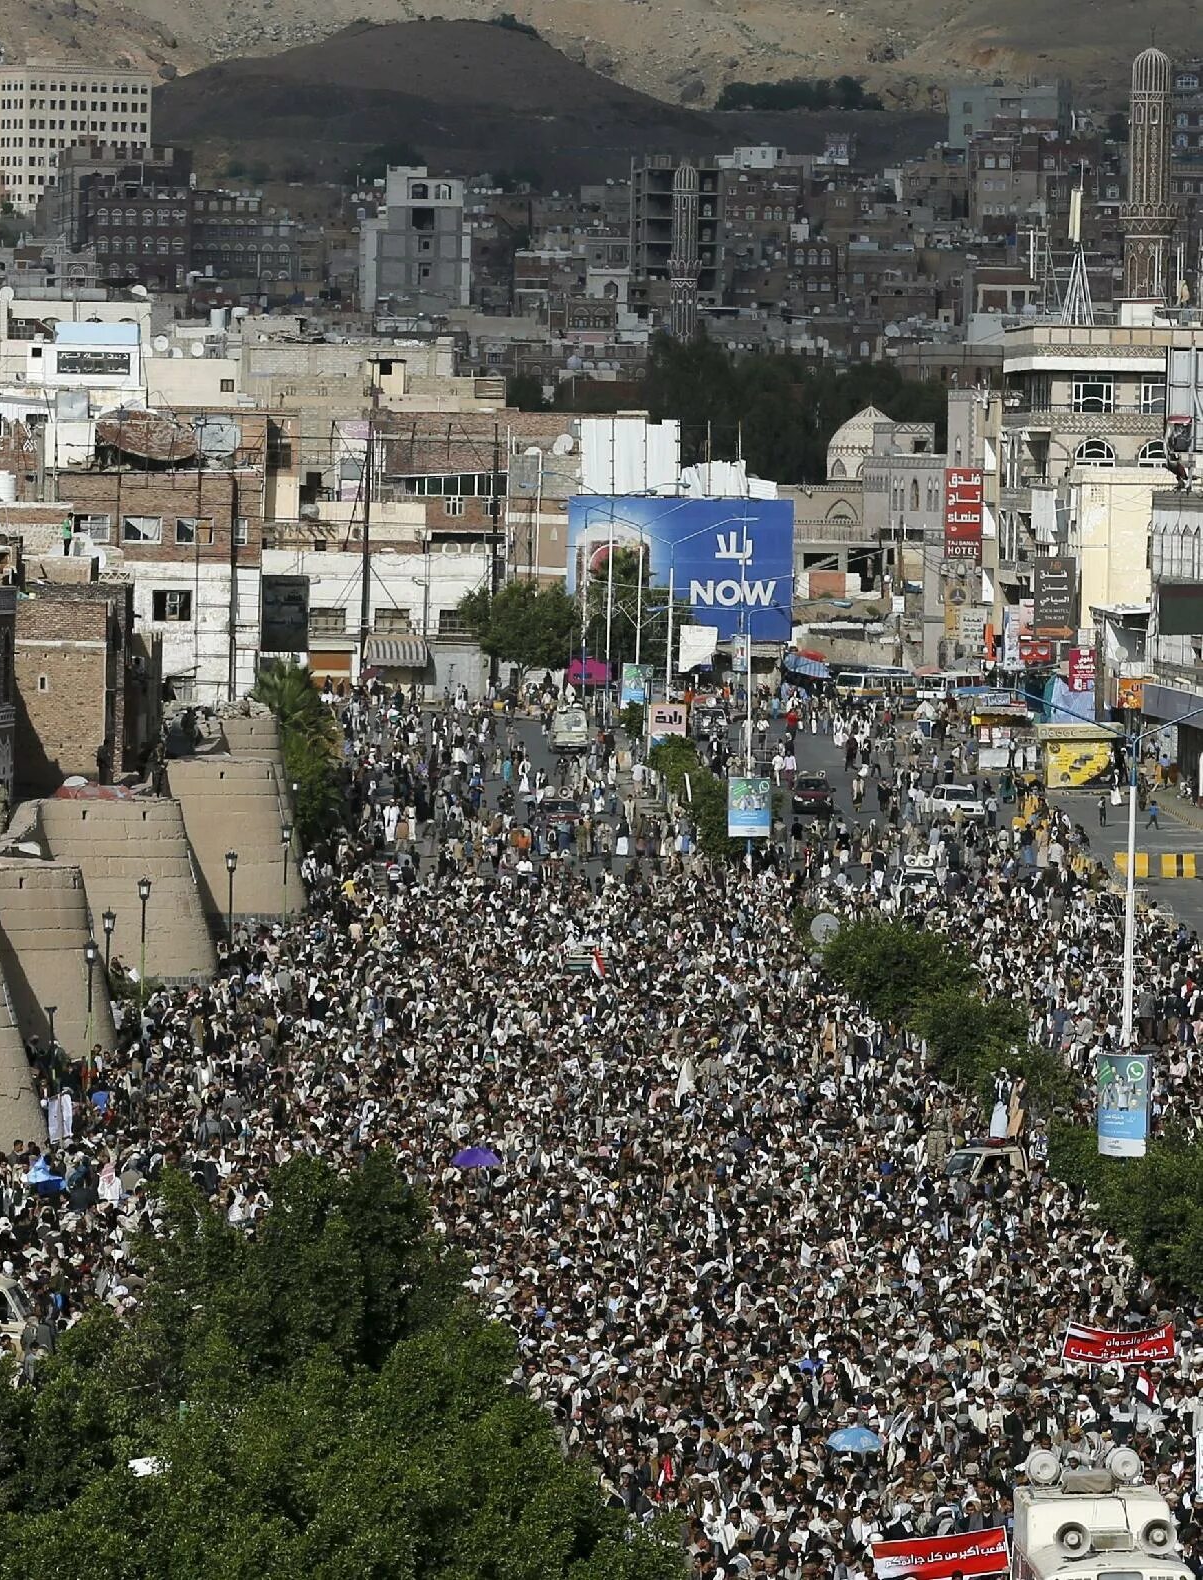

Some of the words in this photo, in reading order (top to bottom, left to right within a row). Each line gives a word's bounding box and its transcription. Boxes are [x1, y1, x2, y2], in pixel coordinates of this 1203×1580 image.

[948, 473, 981, 488] فندق
[948, 491, 981, 506] تاج
[947, 511, 980, 523] صنعاء
[714, 531, 753, 566] يلا
[947, 547, 979, 555] HOTEL
[1039, 569, 1068, 580] فندق
[690, 580, 777, 606] NOW
[1041, 583, 1068, 592] عدن
[1039, 596, 1070, 607] السياحي
[1105, 1336, 1140, 1347] والعدوان
[1141, 1329, 1166, 1342] الحصار
[1070, 1347, 1109, 1360] شعب
[1134, 1345, 1169, 1357] جريمة
[980, 1541, 1007, 1556] لشعب
[927, 1552, 943, 1563] كل
[944, 1552, 958, 1561] من
